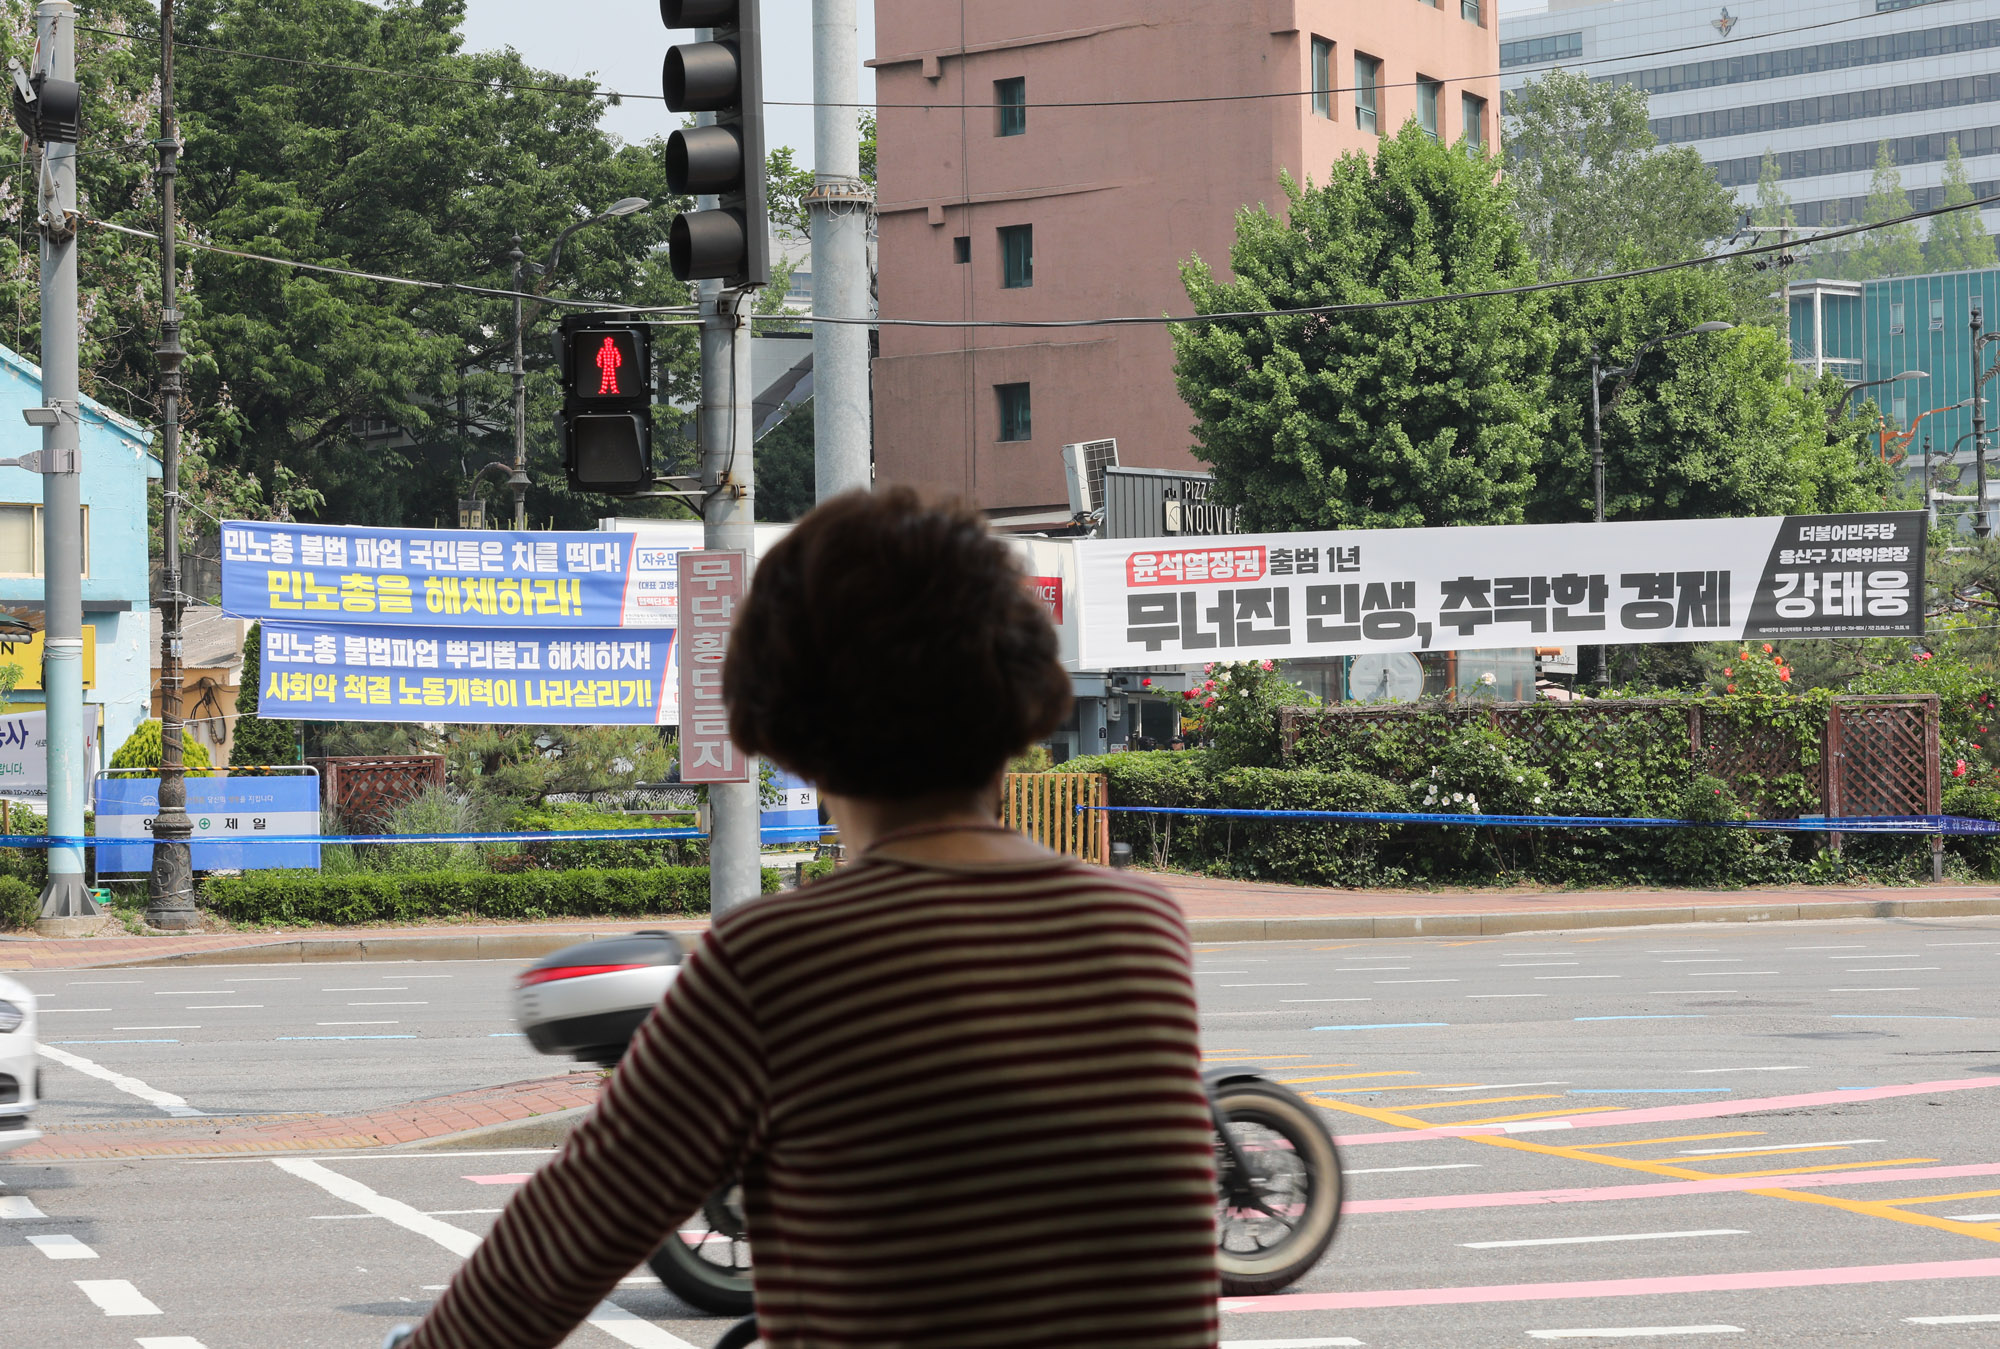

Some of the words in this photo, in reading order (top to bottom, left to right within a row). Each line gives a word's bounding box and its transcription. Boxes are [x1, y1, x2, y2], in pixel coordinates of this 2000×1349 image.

[224, 530, 294, 565] 민노총
[301, 534, 348, 567] 불법
[355, 538, 402, 569] 파업
[409, 540, 504, 572] 국민들은
[512, 541, 559, 573] 치를
[566, 542, 621, 573] 떤다!
[1799, 523, 1897, 541] 더불어민주당
[1132, 550, 1260, 583] 윤석열정권
[1269, 547, 1319, 576] 출범
[1326, 545, 1361, 573] 1년
[1779, 548, 1827, 565] 용산구
[1831, 546, 1910, 563] 지역위원장
[267, 570, 413, 614] 민노총을
[424, 575, 583, 616] 해체하라!
[1127, 586, 1292, 652] 무너진
[1306, 581, 1433, 649] 민생,
[1439, 573, 1609, 636] 추락한
[1620, 570, 1731, 630] 경제
[1772, 570, 1910, 618] 강태웅
[267, 632, 337, 665] 민노총
[344, 636, 439, 668] 불법파업
[446, 639, 541, 670] 뿌리뽑고
[548, 641, 651, 671] 해체하자!
[266, 672, 338, 703] 사회악
[344, 674, 392, 705] 척결
[399, 676, 518, 707] 노동개혁이
[525, 679, 653, 708] 나라살리기!
